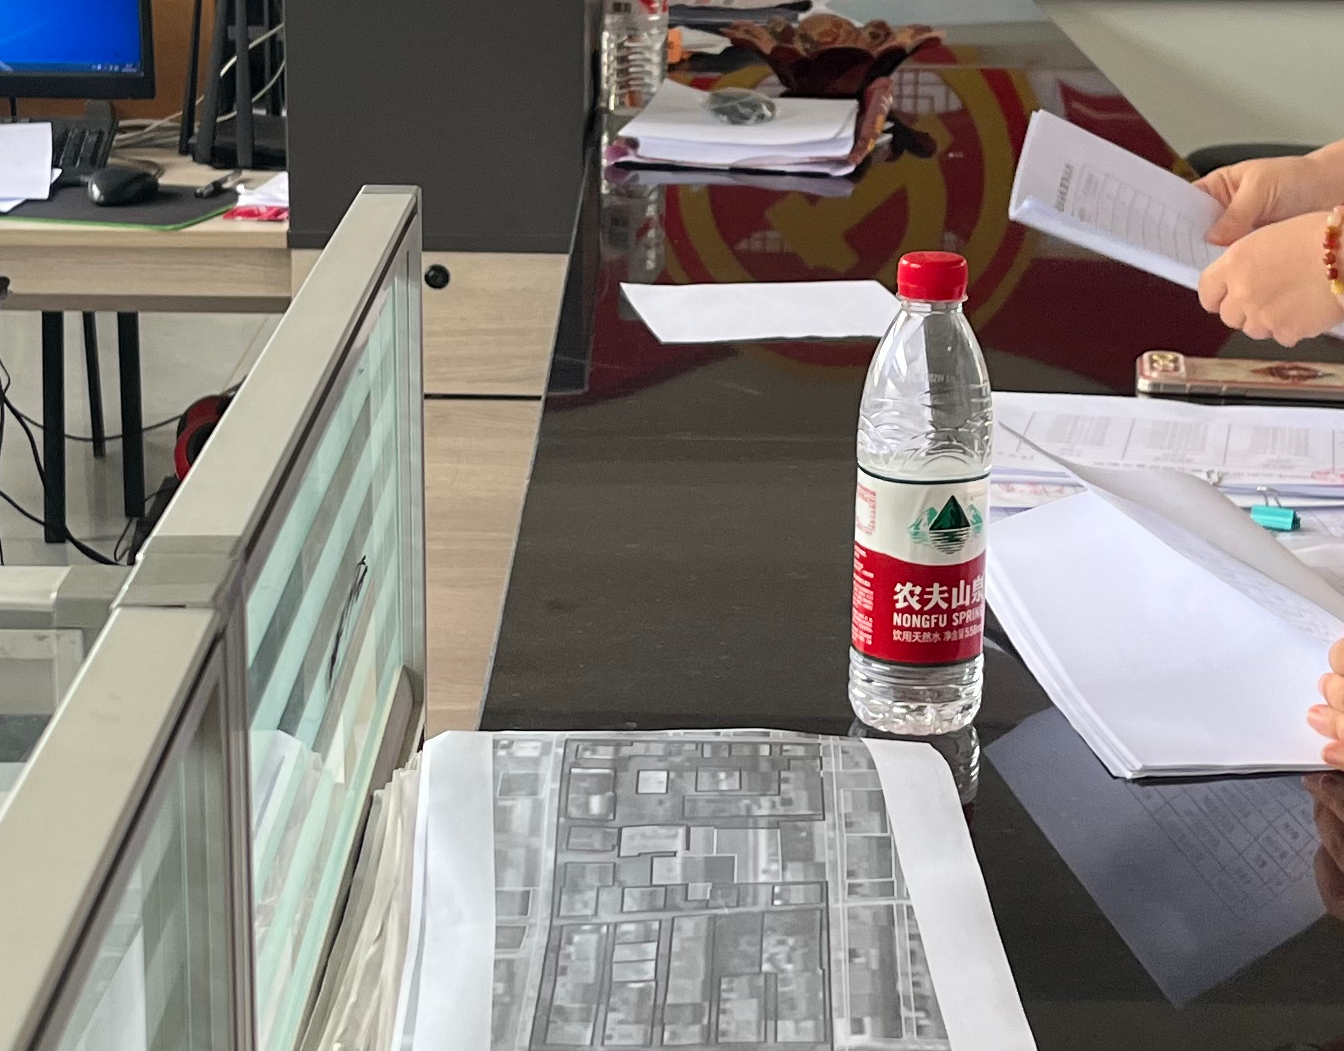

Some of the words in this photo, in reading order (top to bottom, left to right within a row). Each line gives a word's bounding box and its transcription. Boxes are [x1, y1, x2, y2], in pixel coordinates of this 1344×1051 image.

[893, 574, 985, 611] 农夫山泉
[893, 611, 947, 628] NONGFU
[892, 628, 942, 643] 饮用天然水
